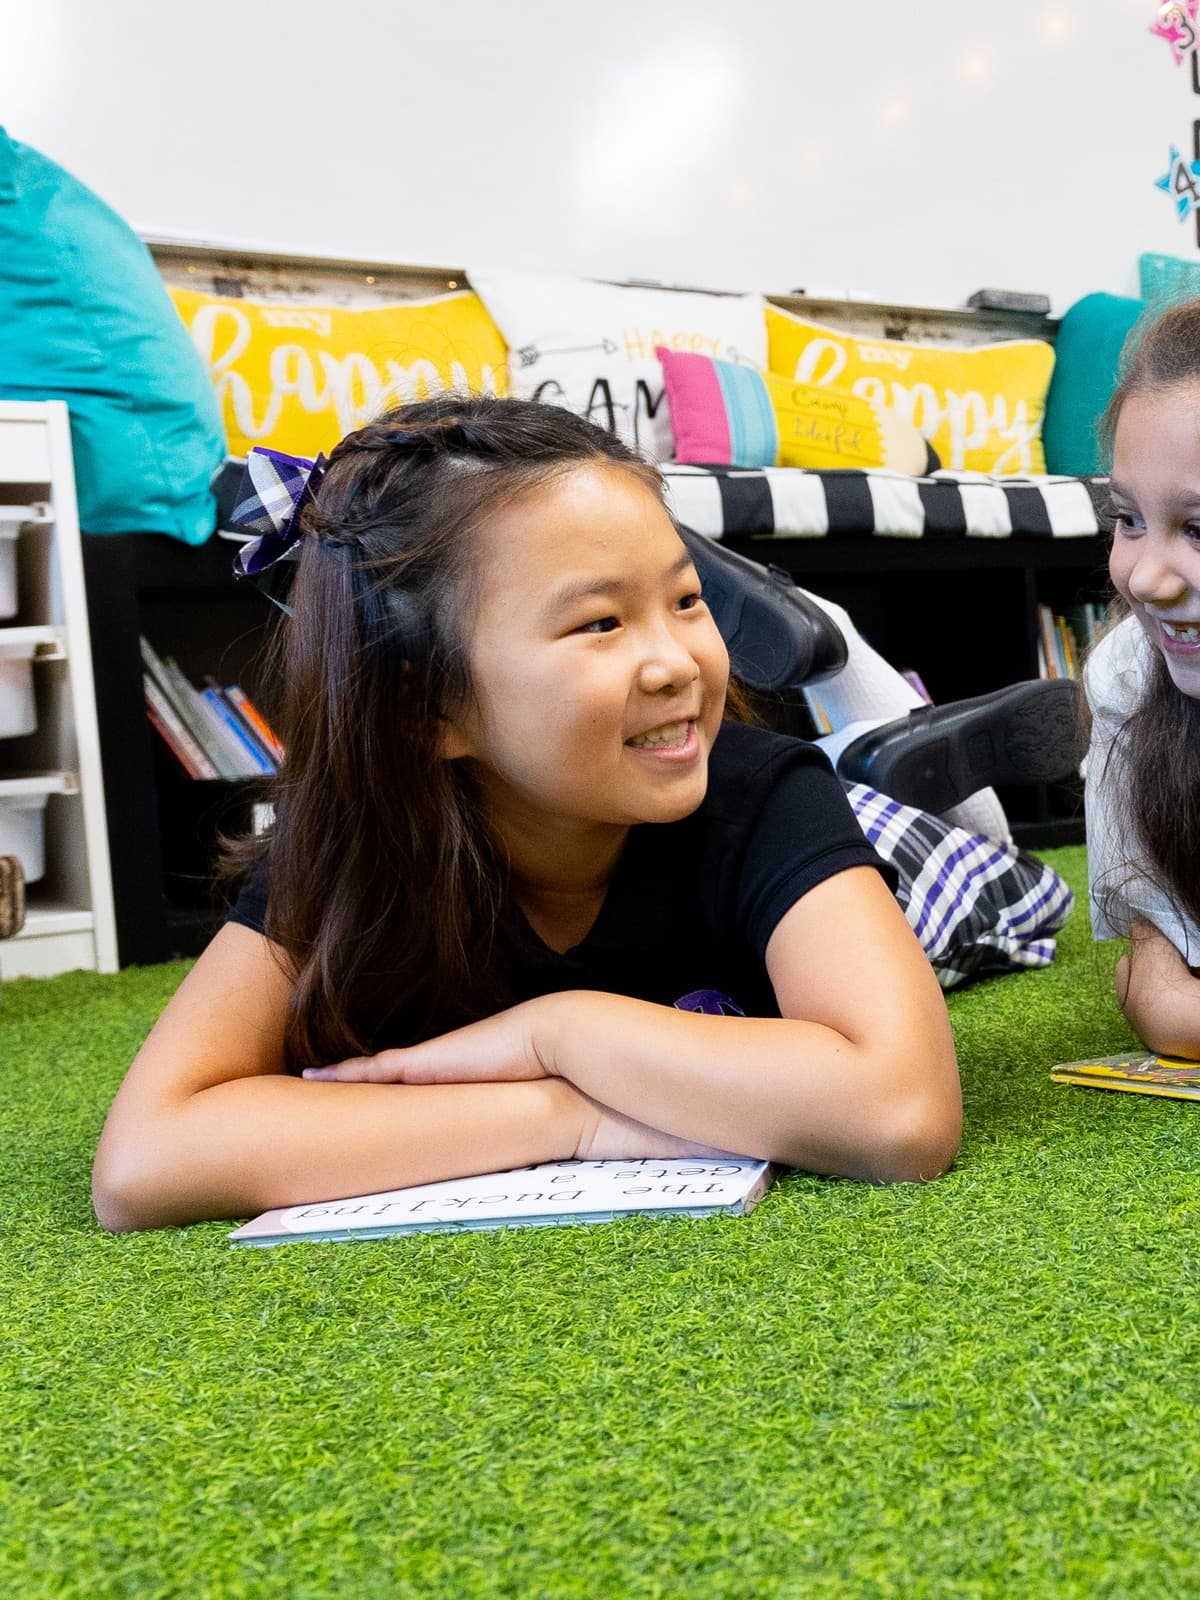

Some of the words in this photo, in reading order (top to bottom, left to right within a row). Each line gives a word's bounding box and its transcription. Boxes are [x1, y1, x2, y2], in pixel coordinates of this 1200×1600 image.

[1163, 4, 1195, 50] 3
[1175, 161, 1200, 202] 4
[621, 328, 721, 363] HAPPY
[856, 345, 913, 370] my
[548, 1173, 577, 1184] a
[612, 1164, 743, 1181] Gets
[291, 1188, 585, 1221] Duckling
[621, 1182, 724, 1200] The
